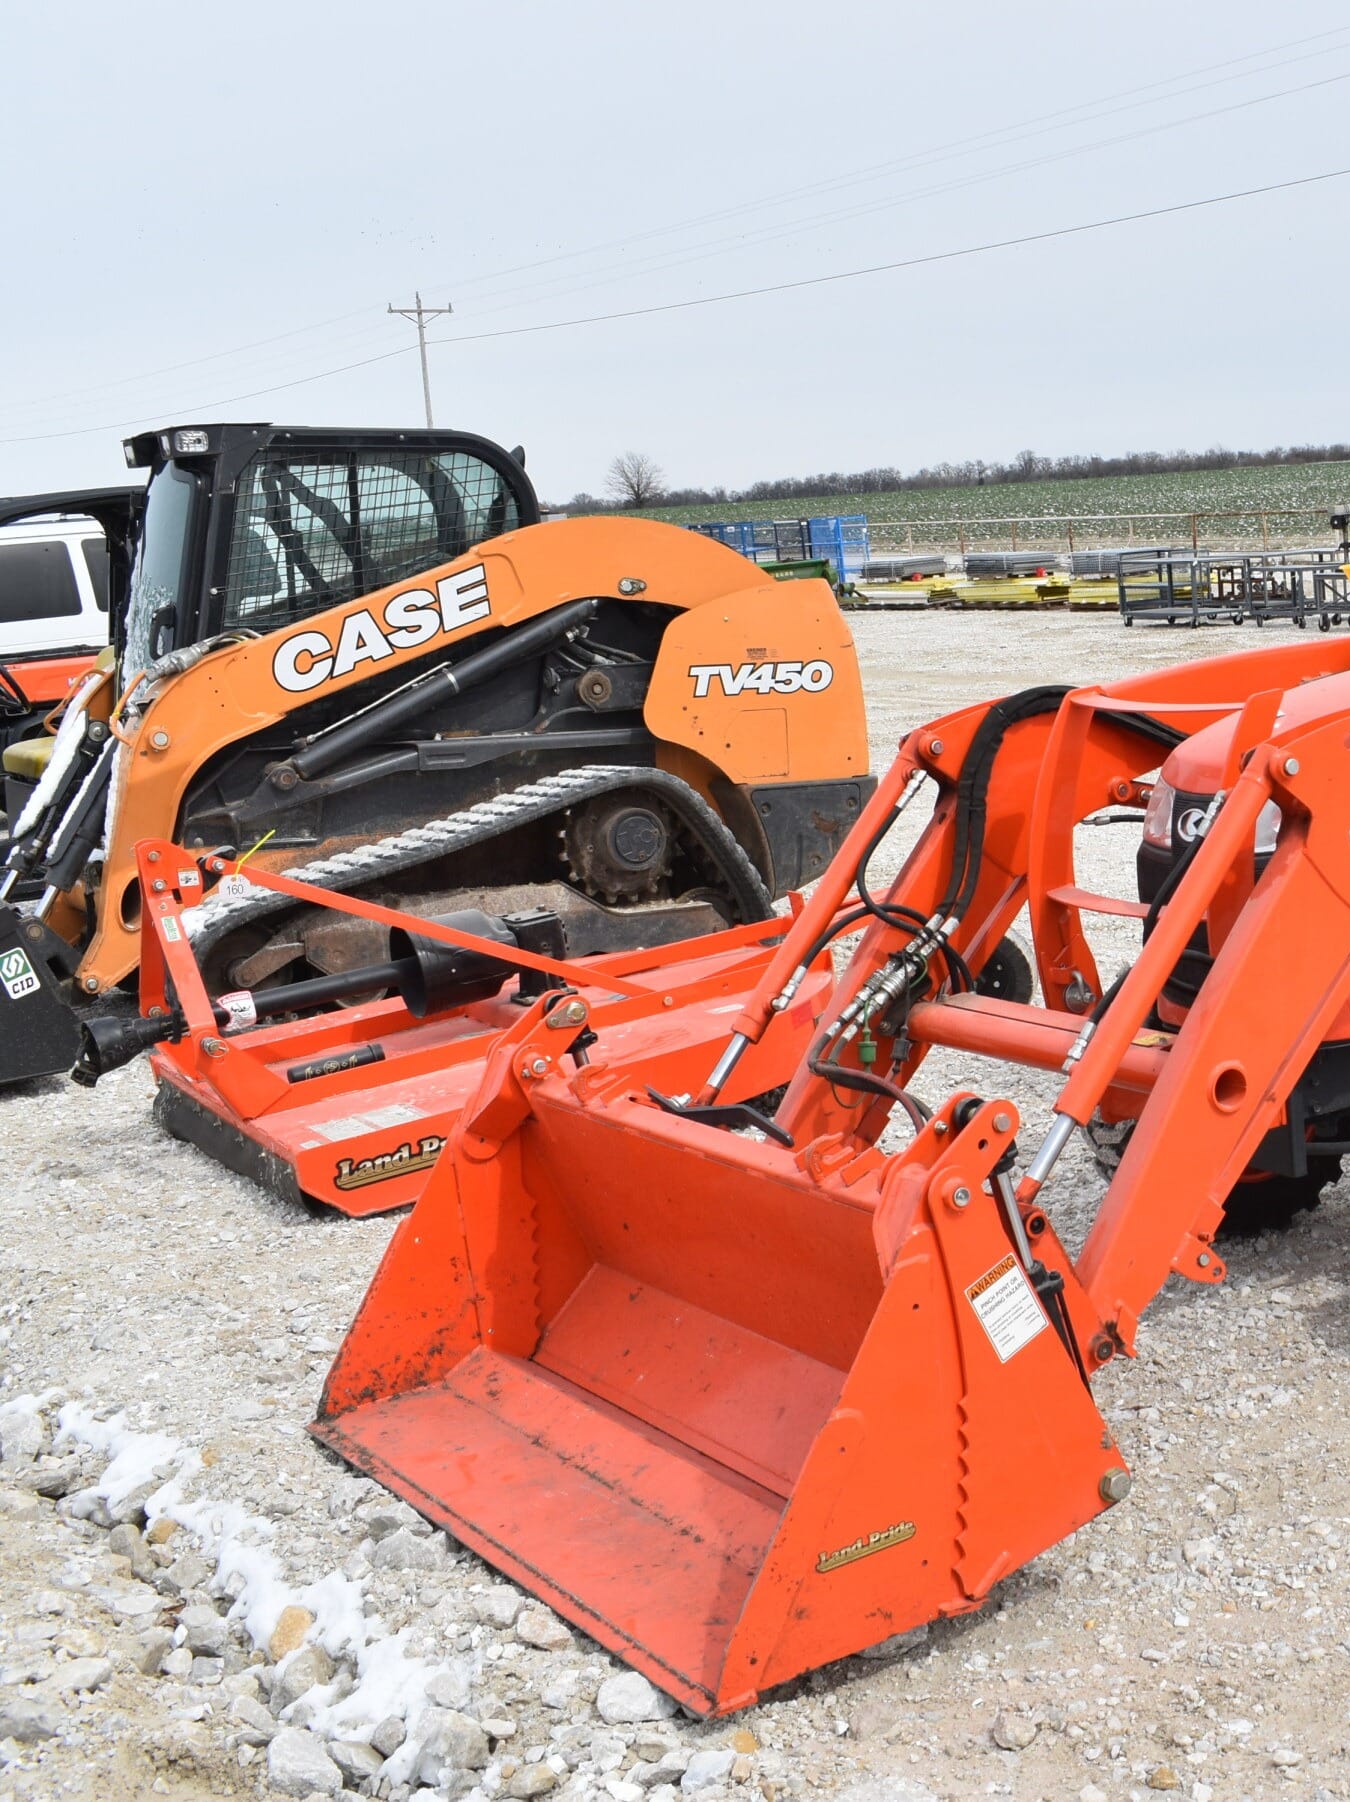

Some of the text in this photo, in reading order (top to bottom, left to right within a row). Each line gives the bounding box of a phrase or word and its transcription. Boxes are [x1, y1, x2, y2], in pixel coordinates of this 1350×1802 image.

[272, 563, 491, 692] CASE
[688, 659, 834, 698] TV450
[226, 884, 244, 895] 160
[12, 976, 34, 995] CID
[336, 1144, 412, 1183] Land
[975, 1257, 1016, 1290] WARNING
[818, 1521, 914, 1565] Land Pride
